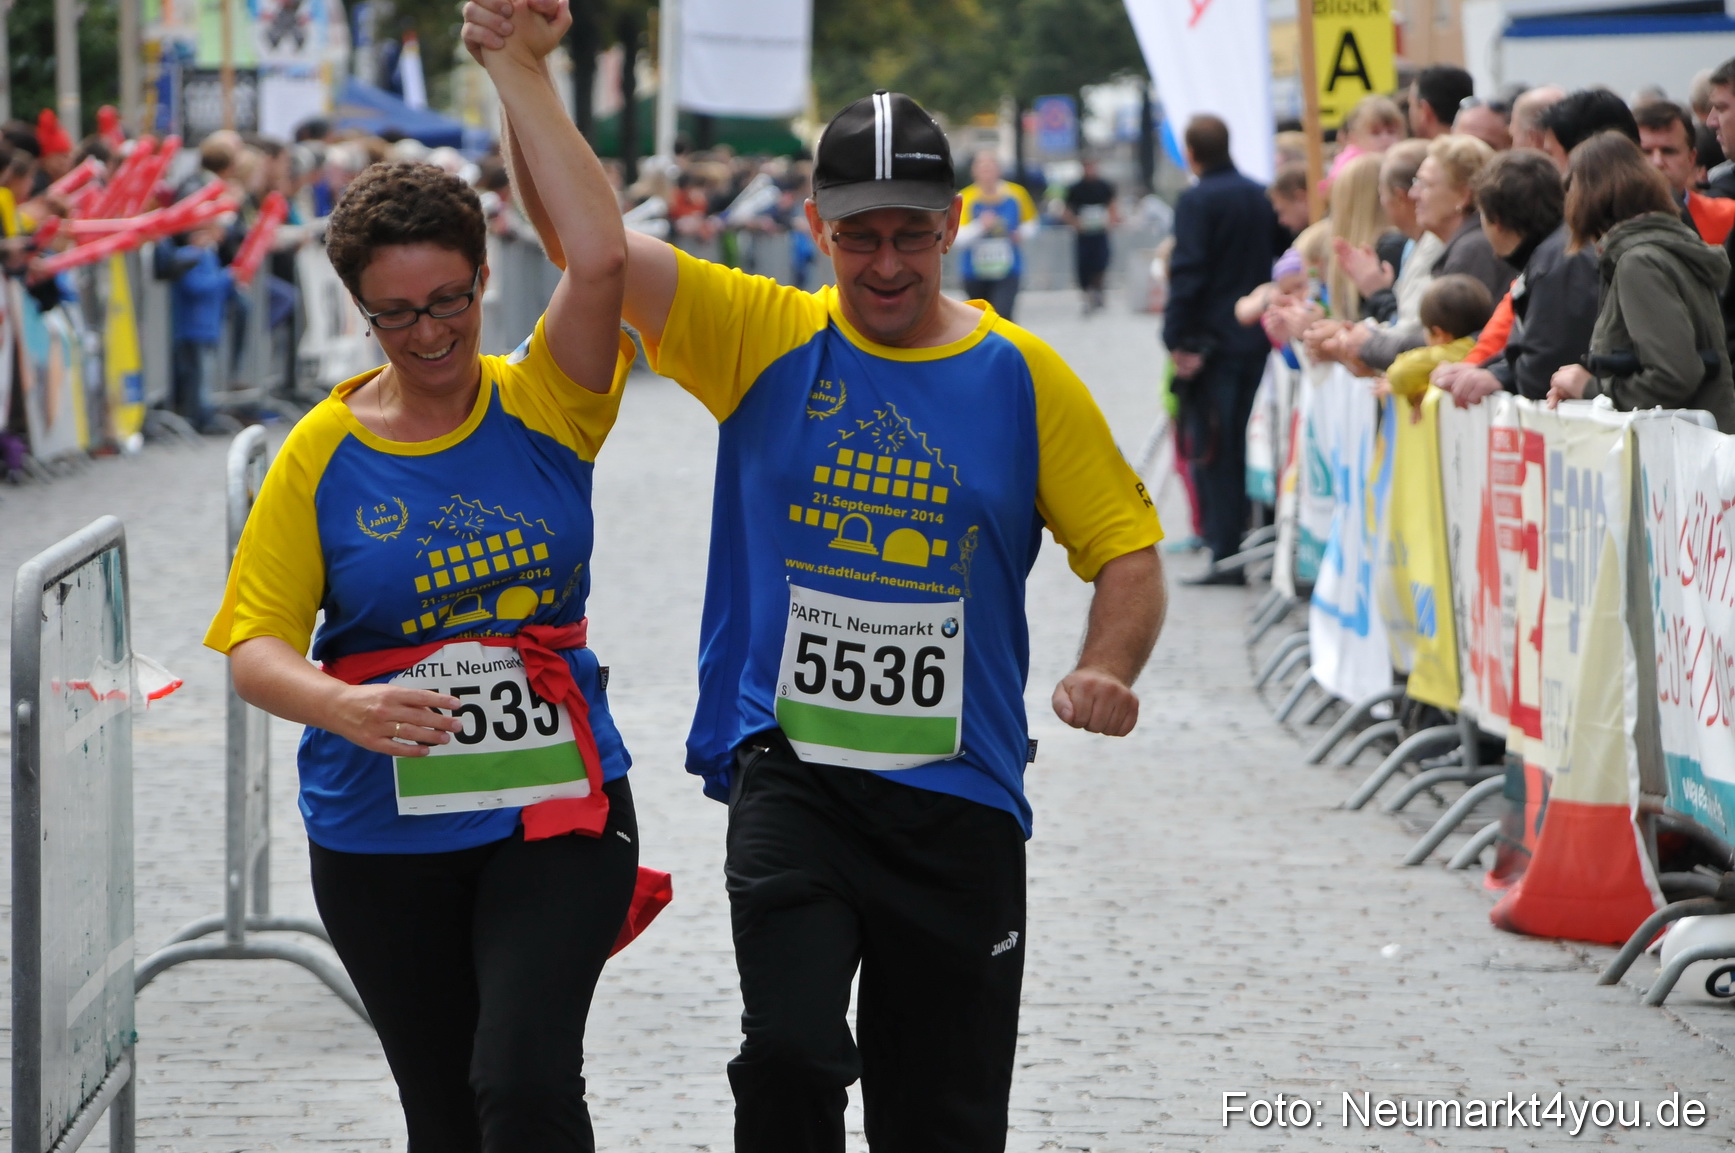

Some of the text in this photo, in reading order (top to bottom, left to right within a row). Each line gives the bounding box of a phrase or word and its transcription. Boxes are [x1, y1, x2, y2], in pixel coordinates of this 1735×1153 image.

[1327, 31, 1372, 92] A
[819, 379, 832, 389] 15
[370, 513, 399, 528] Jahre
[373, 503, 387, 514] 15
[812, 492, 944, 524] 21.September 2014
[421, 567, 551, 608] 21.September 2014
[785, 558, 962, 596] www.stadtlauf-neumarkt.de
[790, 602, 934, 636] PARTL Neumarkt
[394, 656, 526, 679] ARTL Neumark
[793, 631, 946, 708] 5536
[781, 684, 788, 696] S
